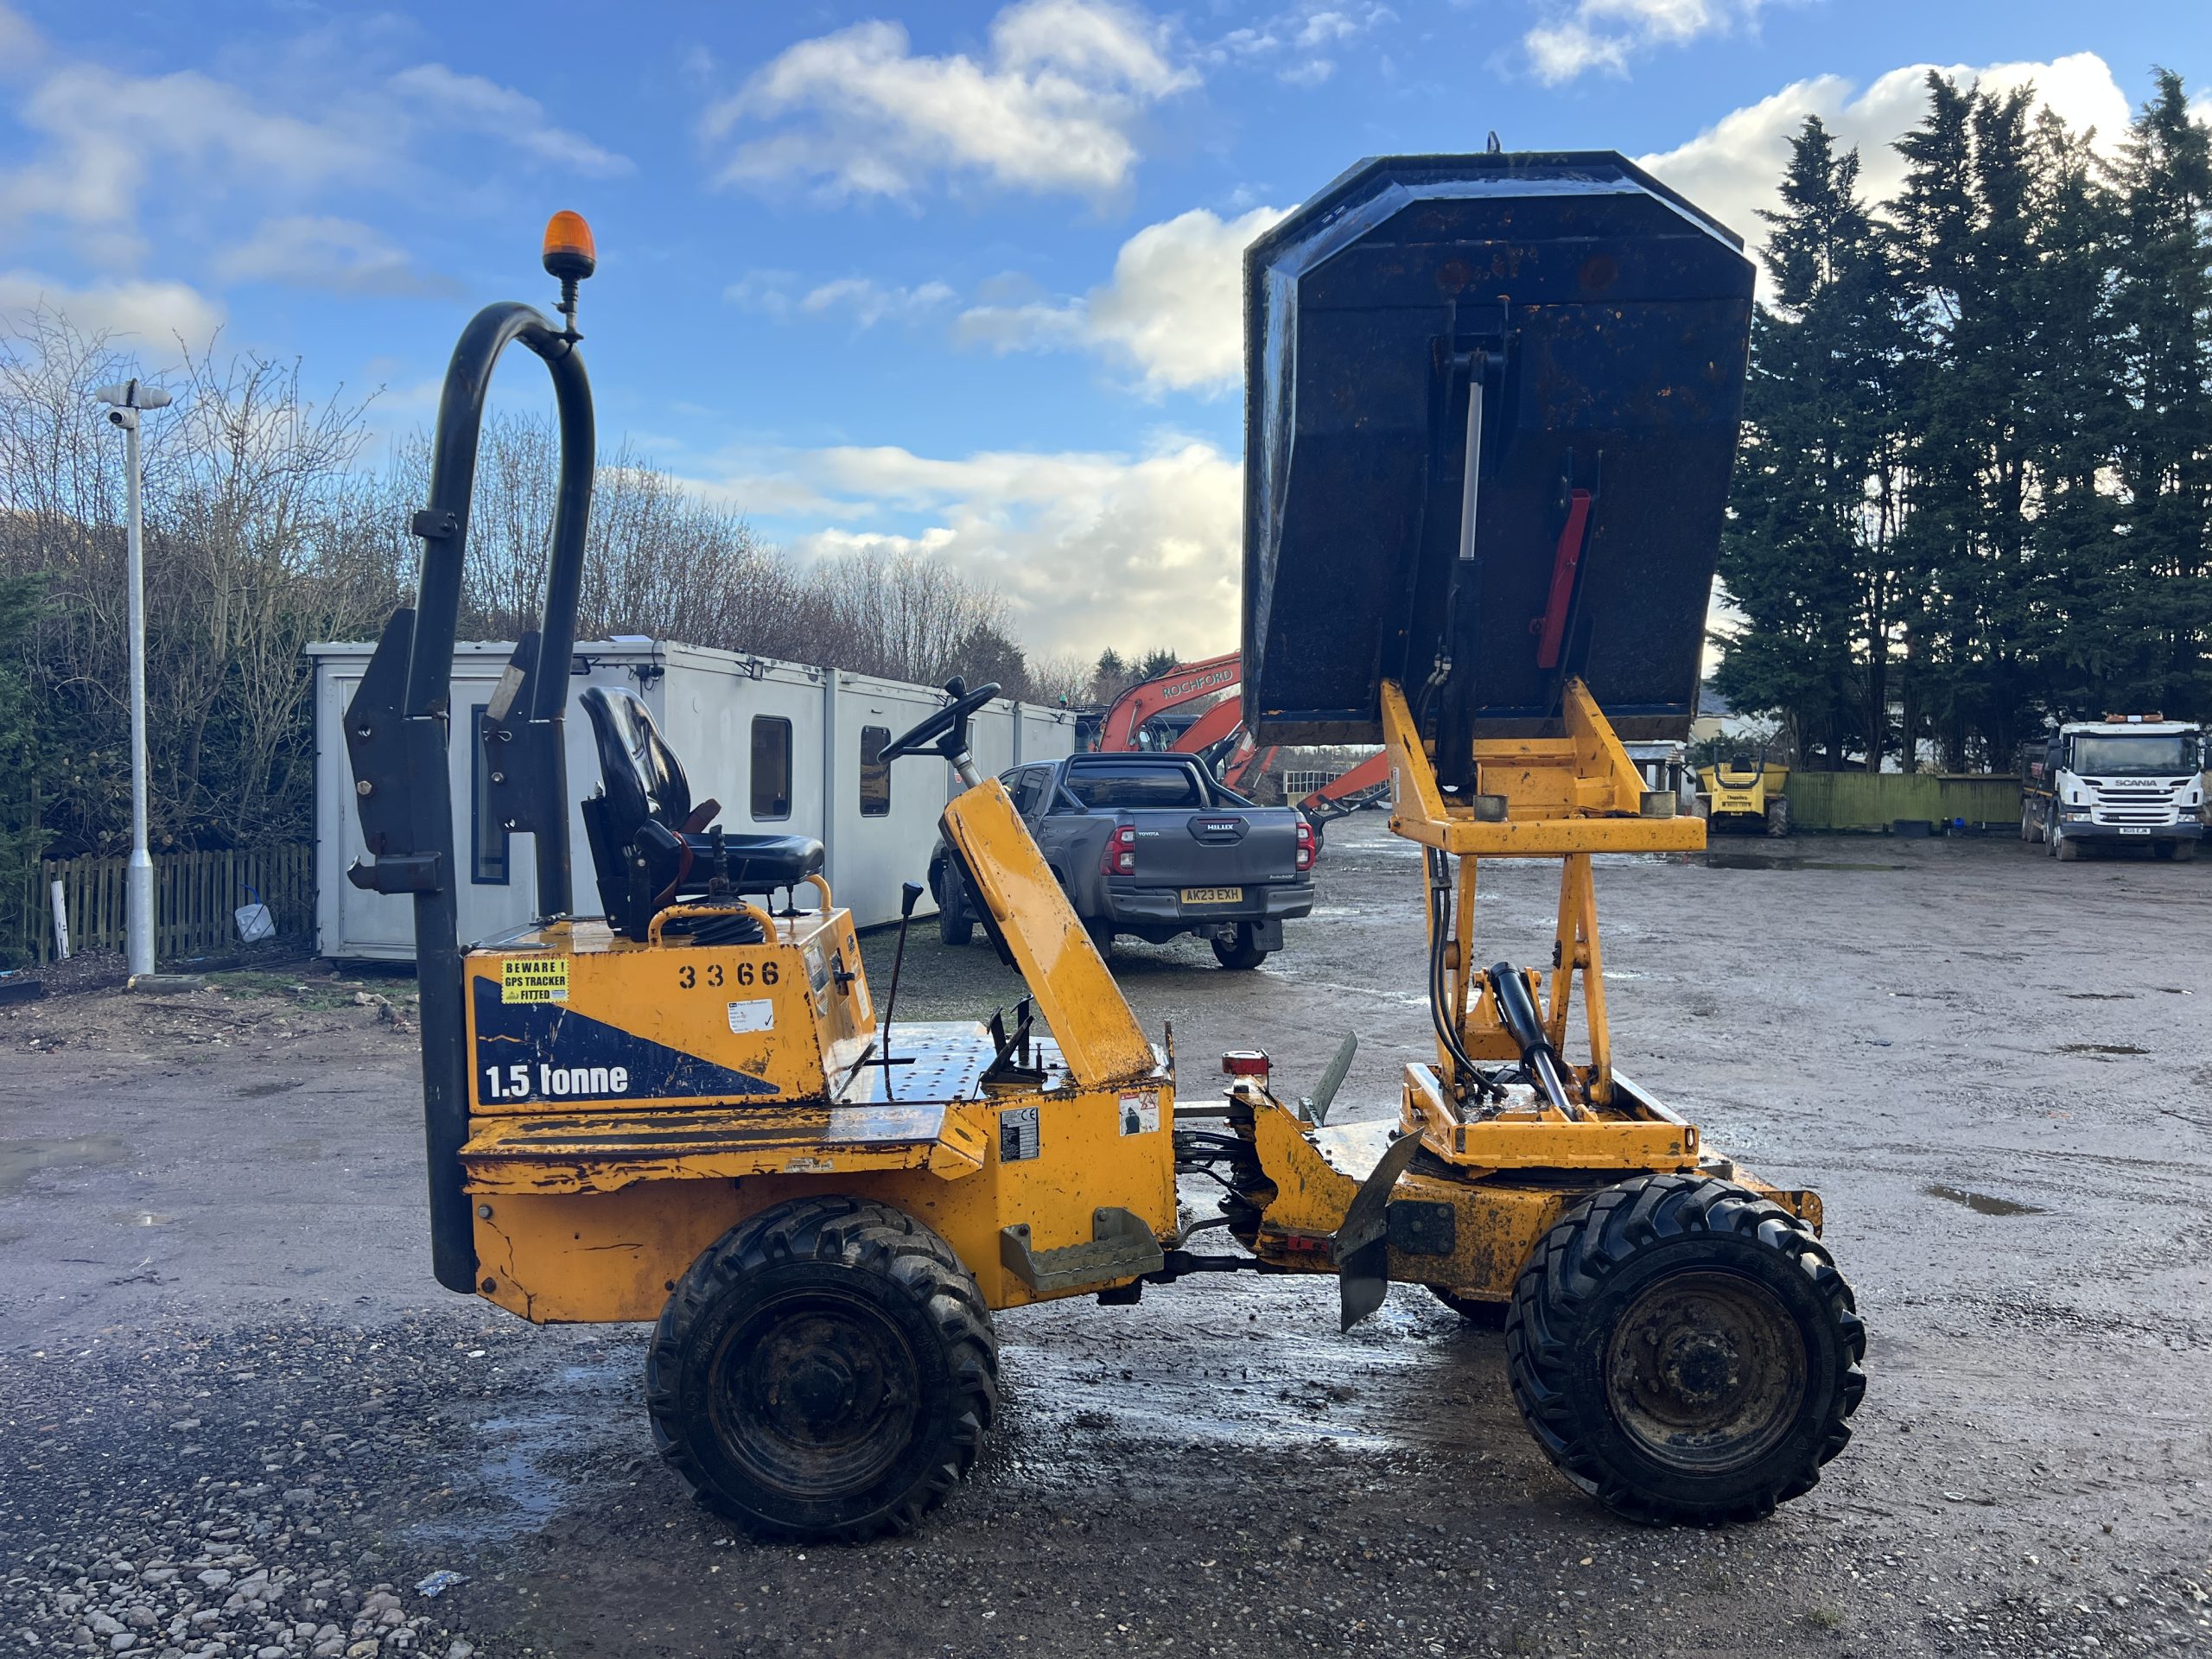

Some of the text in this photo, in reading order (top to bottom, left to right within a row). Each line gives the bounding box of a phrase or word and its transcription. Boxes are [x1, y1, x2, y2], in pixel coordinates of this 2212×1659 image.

[1162, 668, 1233, 699] ROCHFORD
[1186, 887, 1239, 900] AK23 EXH
[506, 963, 556, 973] BEWARE
[505, 976, 565, 987] GPS TRACKER
[521, 990, 550, 1000] FITTED
[486, 1064, 628, 1097] 1.5 tonne
